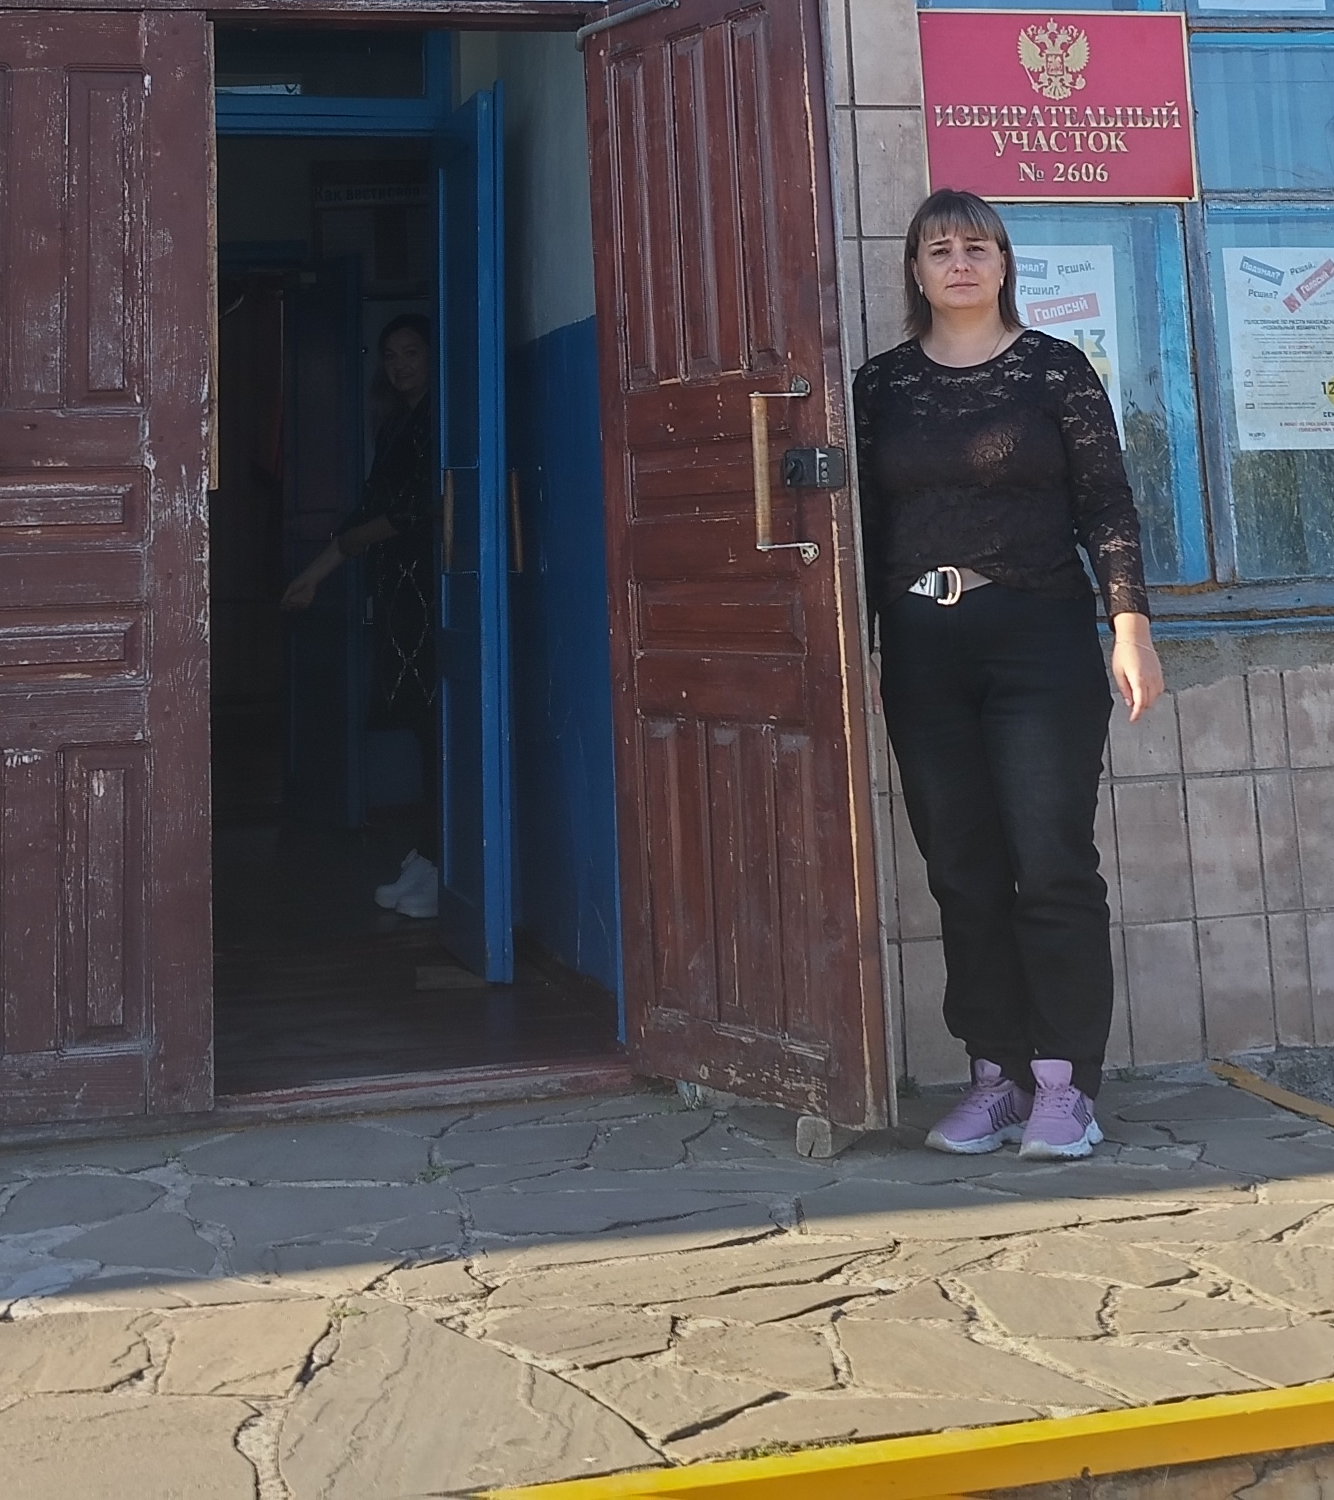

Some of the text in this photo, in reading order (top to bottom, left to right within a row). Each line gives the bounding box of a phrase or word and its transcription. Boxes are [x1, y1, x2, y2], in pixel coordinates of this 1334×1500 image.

[933, 100, 1182, 129] ИЗБИРАТЕЛЬНЫЙ
[991, 130, 1129, 157] УЧАСТОК
[1018, 161, 1109, 182] № 2606
